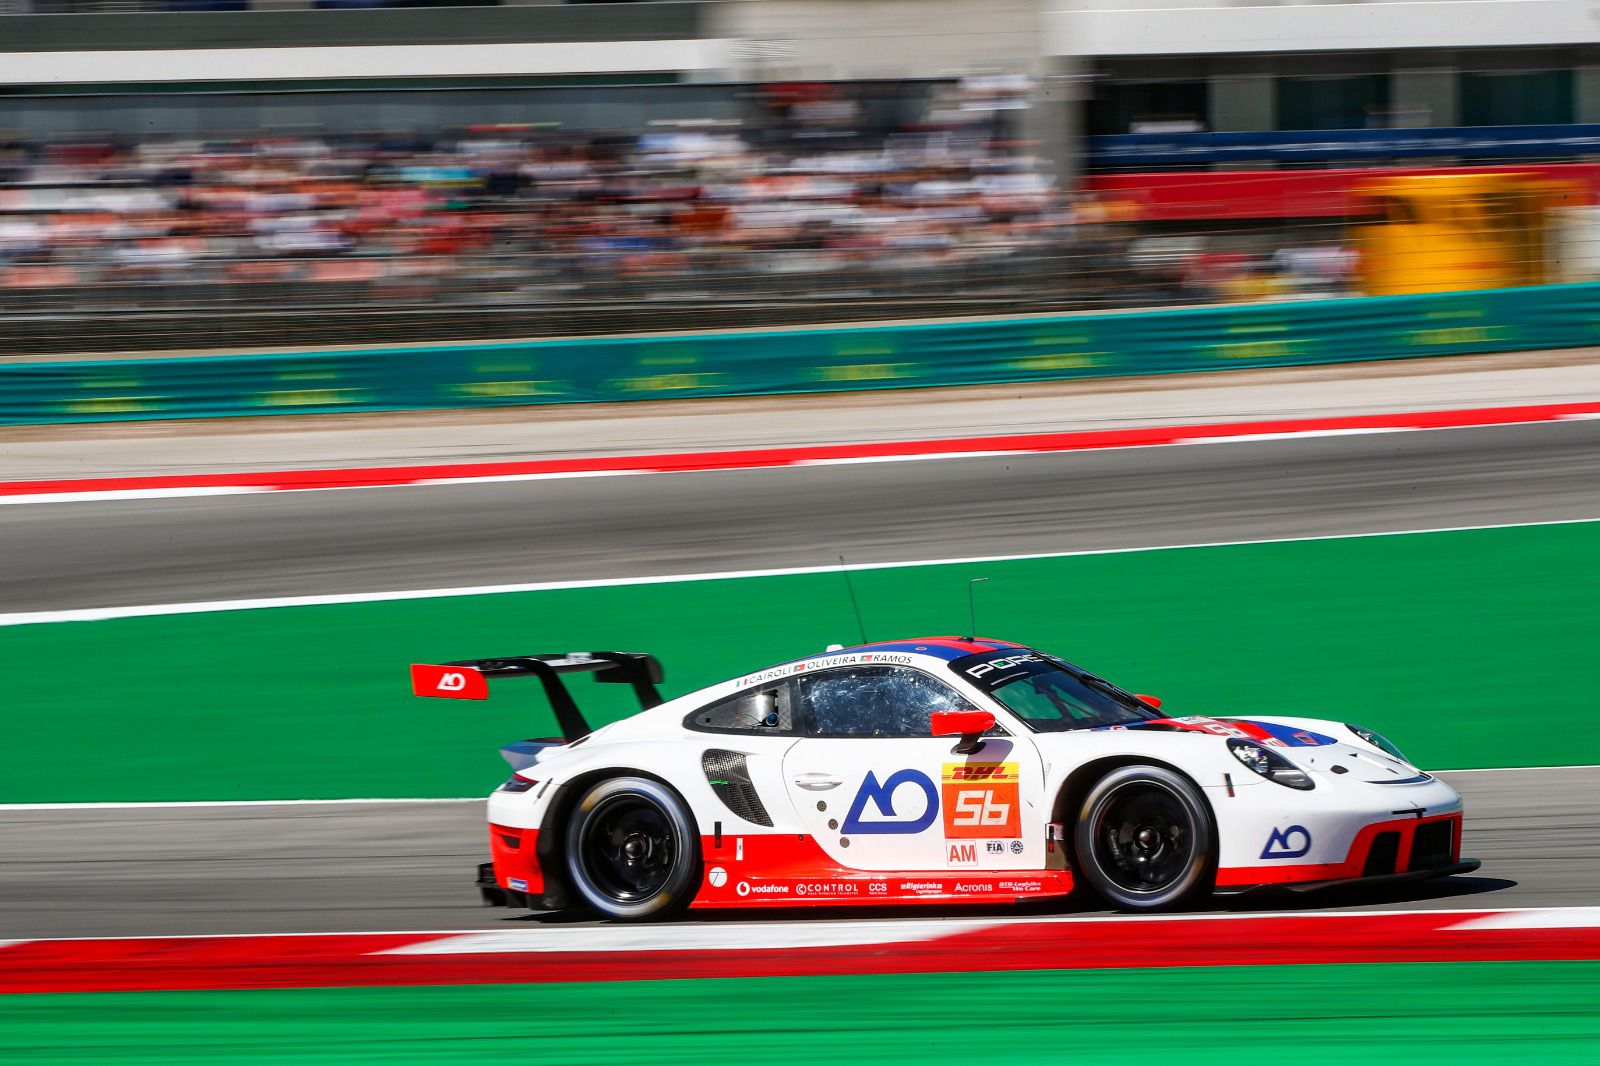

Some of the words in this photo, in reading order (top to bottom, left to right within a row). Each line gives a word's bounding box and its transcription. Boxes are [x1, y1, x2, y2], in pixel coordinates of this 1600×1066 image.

[807, 655, 857, 670] OLIVEIRA
[873, 654, 912, 664] RAMOS
[749, 666, 791, 684] CAIROLI
[952, 766, 1009, 780] DHL
[953, 790, 1010, 826] 56
[986, 843, 1003, 852] FIA
[949, 844, 977, 863] AM
[751, 884, 789, 893] vodafone
[807, 883, 859, 892] CONTROL
[868, 882, 887, 892] CCS
[954, 882, 993, 892] Acronis
